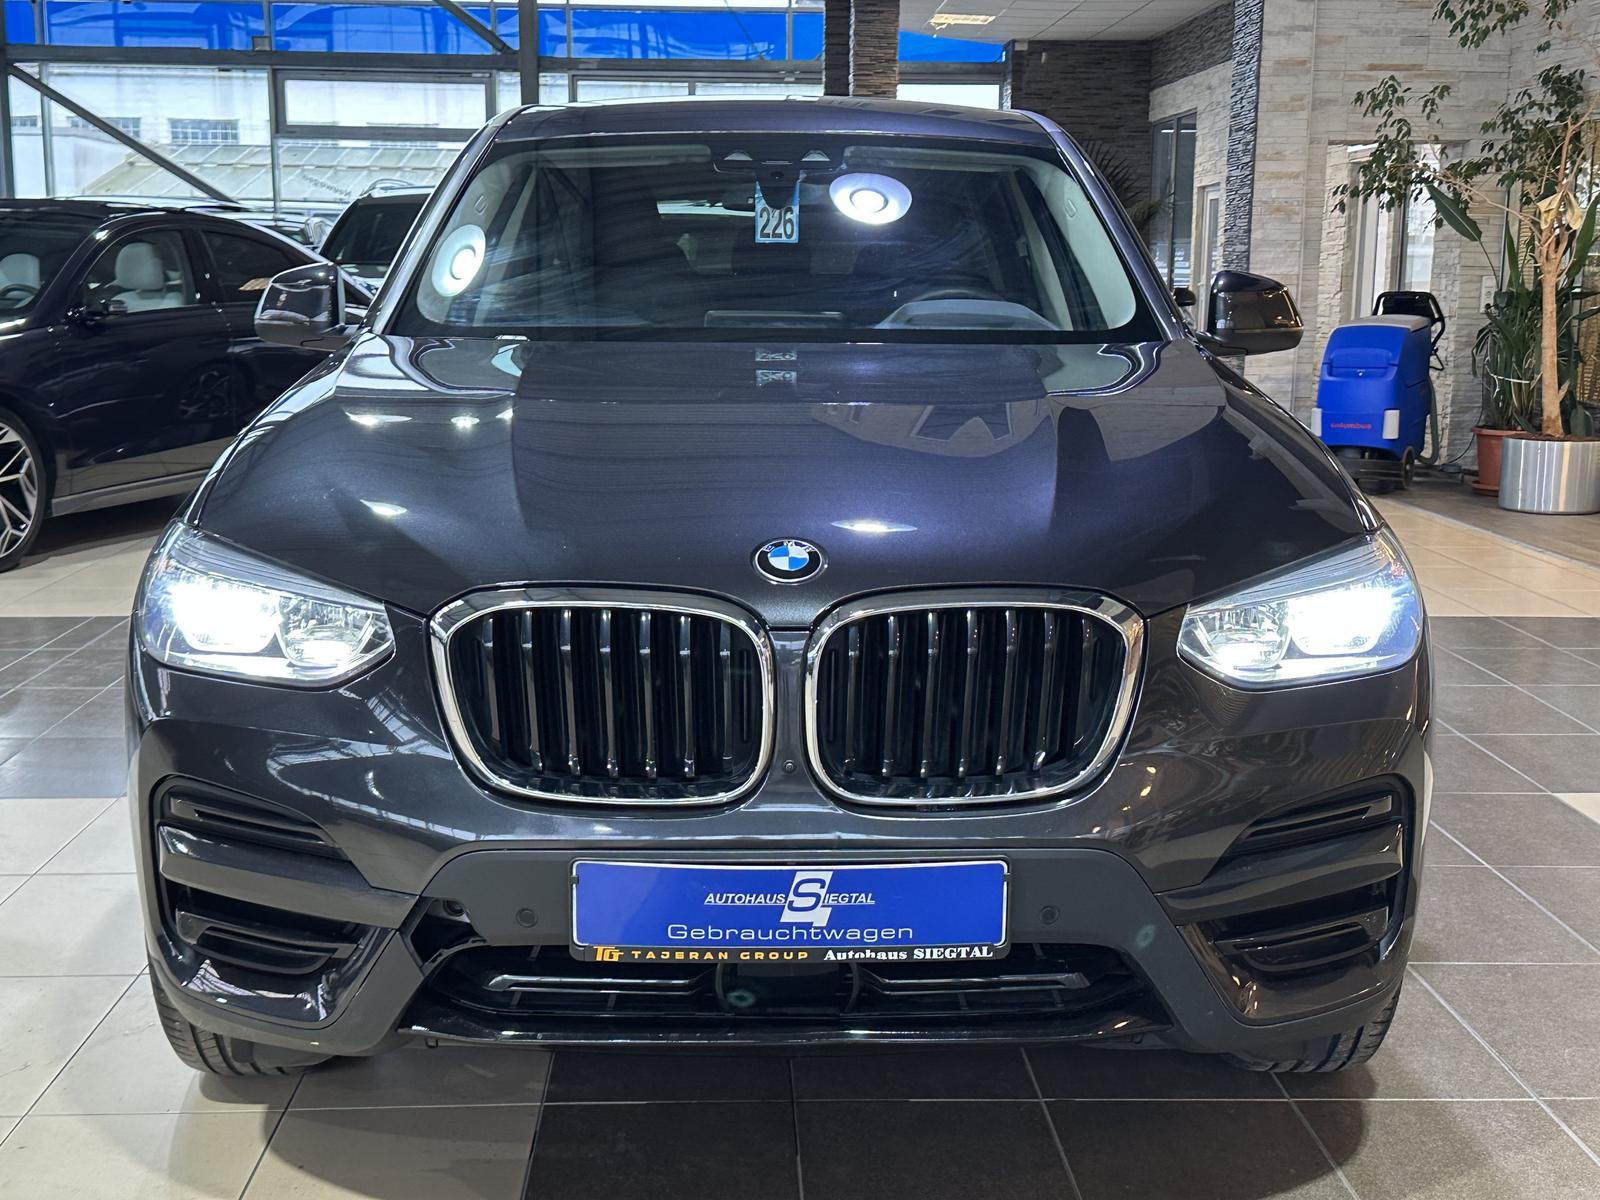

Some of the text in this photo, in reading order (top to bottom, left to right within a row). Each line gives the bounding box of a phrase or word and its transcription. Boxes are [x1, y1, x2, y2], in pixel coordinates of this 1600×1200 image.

[759, 206, 795, 240] 226
[762, 540, 816, 552] BMW
[704, 893, 786, 904] AUTOHAUS
[667, 923, 913, 942] Gebrauchtwagen
[631, 951, 729, 960] TAJERAN
[740, 951, 809, 960] GROUP
[823, 949, 908, 961] Autohaus
[913, 946, 994, 960] SIEGTAL
